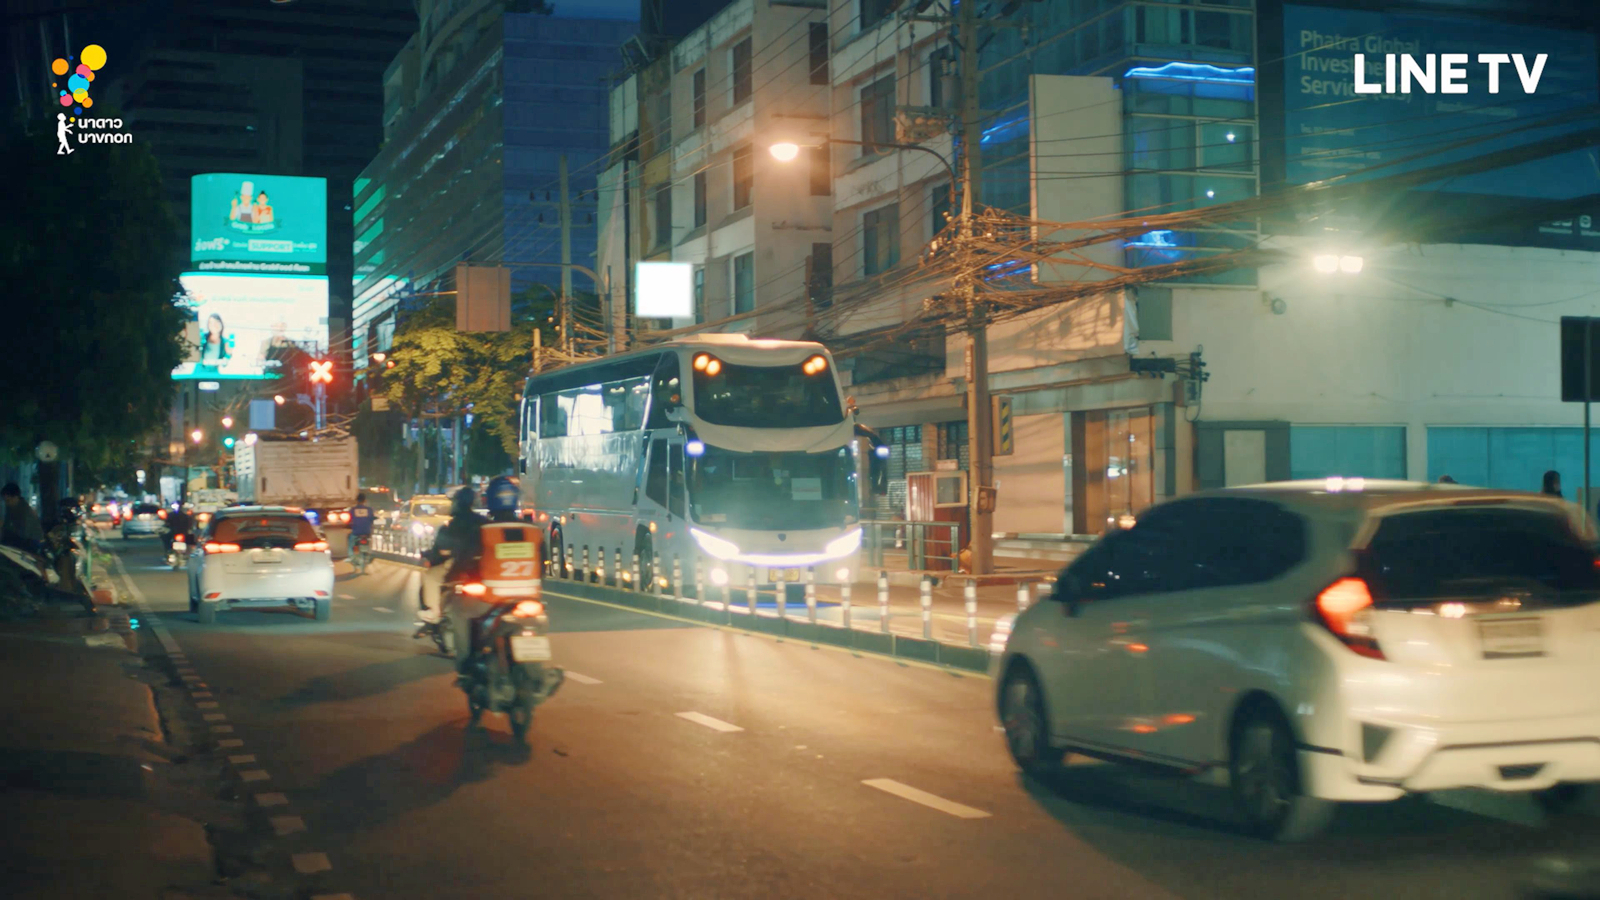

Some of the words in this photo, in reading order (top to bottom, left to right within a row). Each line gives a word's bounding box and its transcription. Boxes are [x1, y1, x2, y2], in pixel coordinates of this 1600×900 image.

[1300, 29, 1360, 52] Phatra
[1364, 35, 1420, 57] Global
[250, 242, 291, 252] SUPPORT
[500, 561, 536, 577] 27
